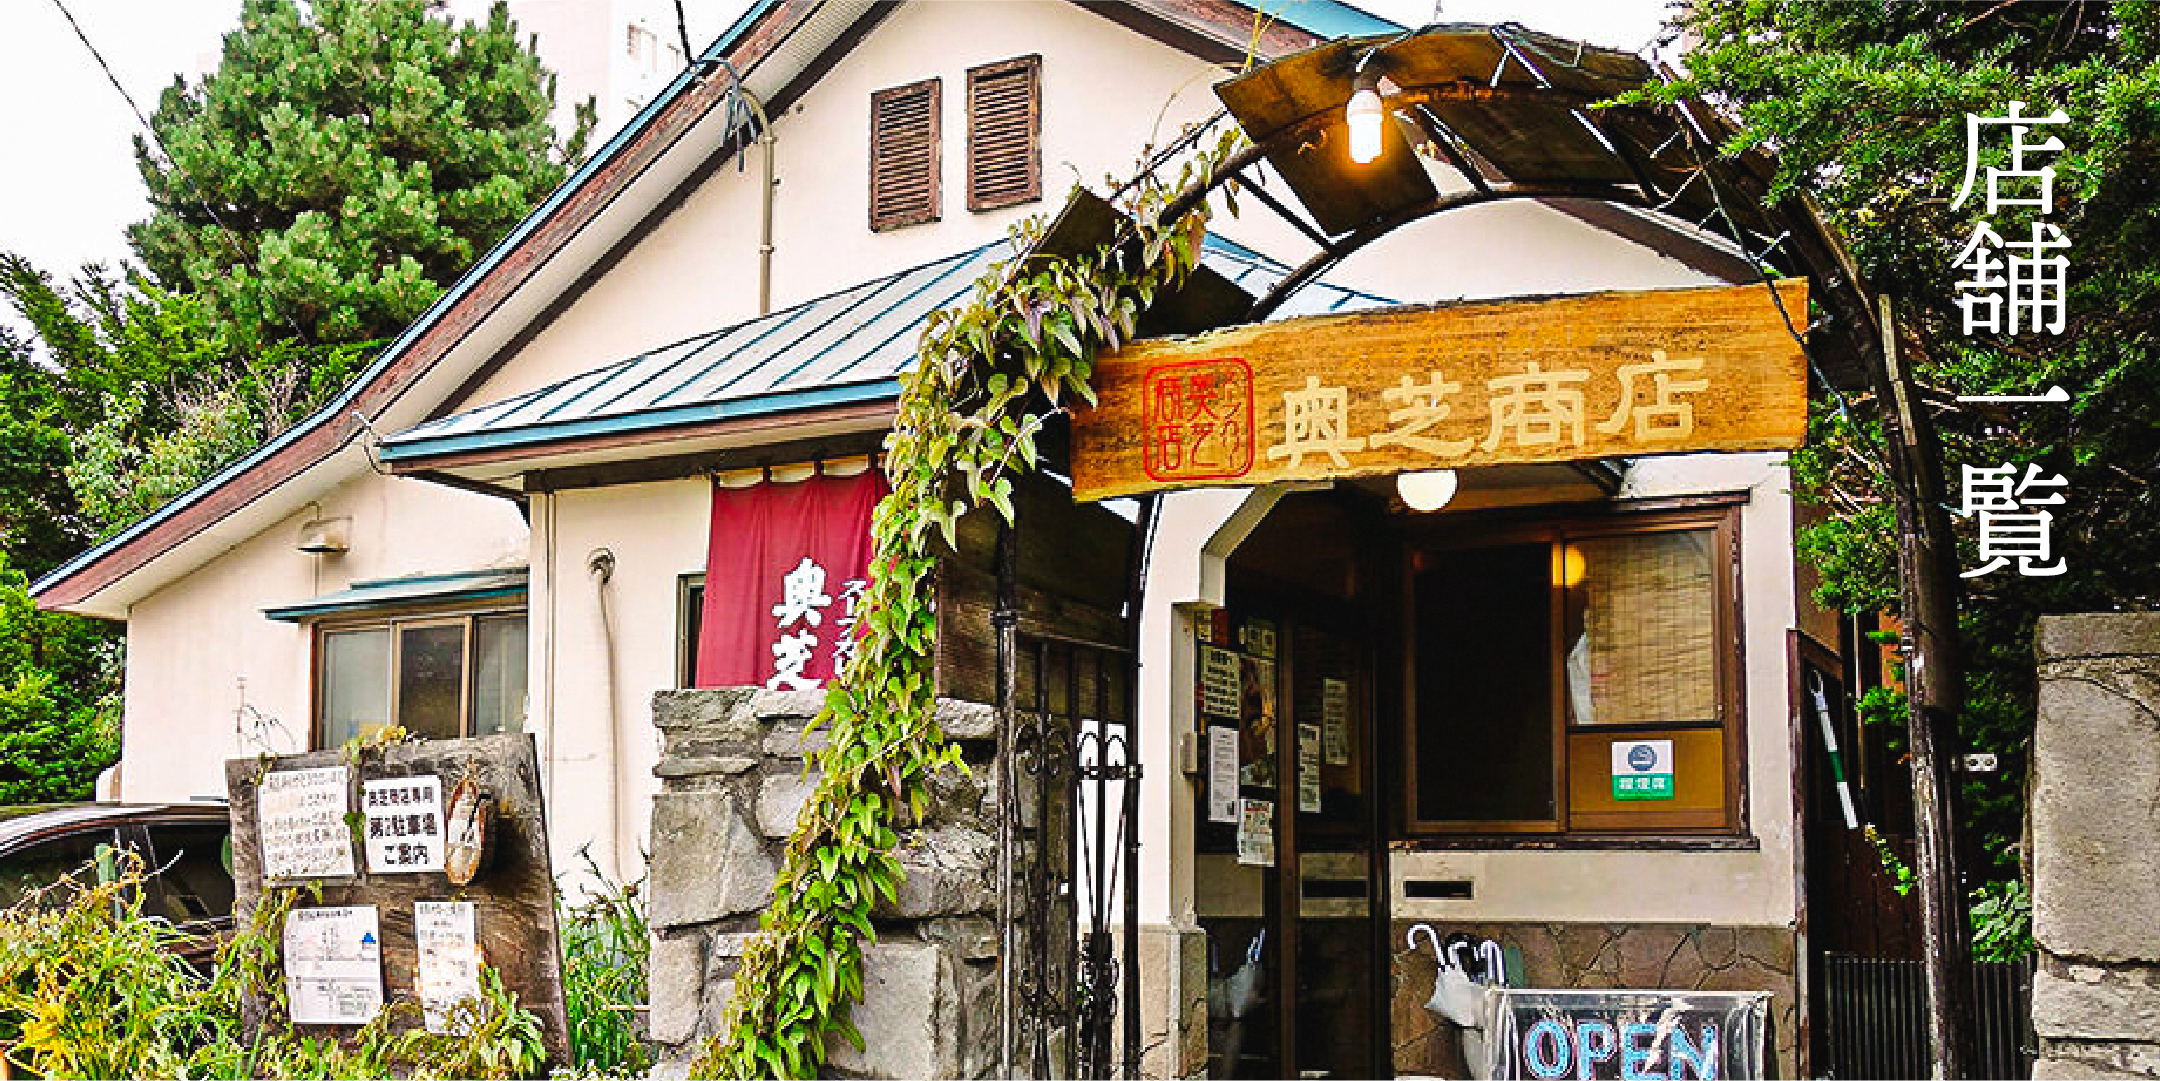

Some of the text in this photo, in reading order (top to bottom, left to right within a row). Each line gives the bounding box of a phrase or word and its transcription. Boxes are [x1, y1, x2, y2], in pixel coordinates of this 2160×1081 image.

[1267, 349, 1709, 468] 奥芝商店
[765, 556, 834, 690] 奥芝
[368, 812, 438, 839] 第2駐車場
[384, 841, 431, 865] ご案内
[1522, 1017, 1721, 1081] OPEN
